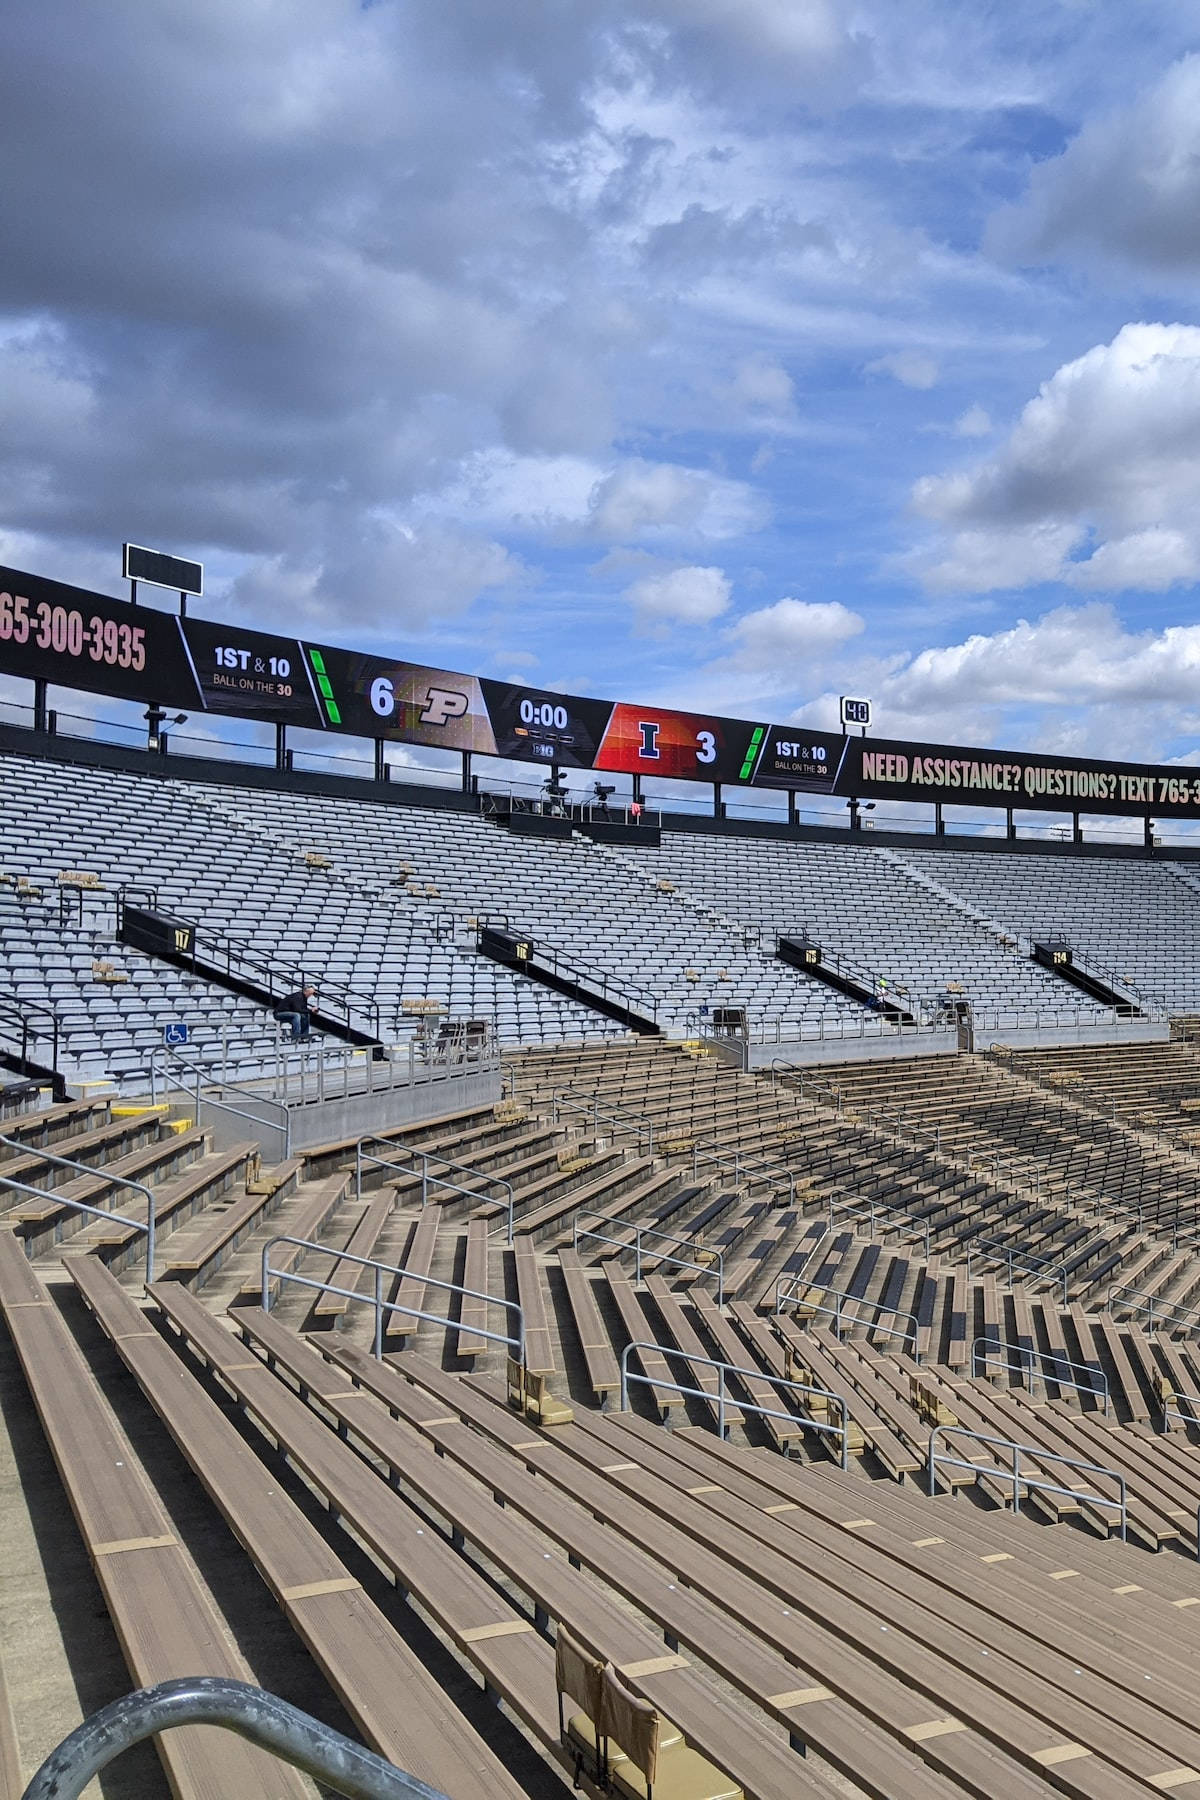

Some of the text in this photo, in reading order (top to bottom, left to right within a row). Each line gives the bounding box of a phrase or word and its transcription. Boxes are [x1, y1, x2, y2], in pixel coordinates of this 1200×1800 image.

[215, 647, 291, 678] 1ST & 10
[213, 674, 293, 697] BALL ON THE 30
[370, 677, 395, 717] 6
[419, 687, 469, 727] P
[520, 700, 568, 729] 0:00
[847, 703, 868, 721] 40
[639, 721, 660, 760] I
[696, 731, 717, 763] 3
[775, 741, 826, 760] 1ST & 10
[775, 760, 828, 774] BALL ON THE 30
[862, 752, 909, 783] NEED
[911, 756, 1021, 792] ASSISTANCE?
[1024, 766, 1117, 799] QUESTIONS?
[1119, 775, 1157, 803] TEXT
[175, 929, 190, 951] 117
[1053, 951, 1067, 964] 114
